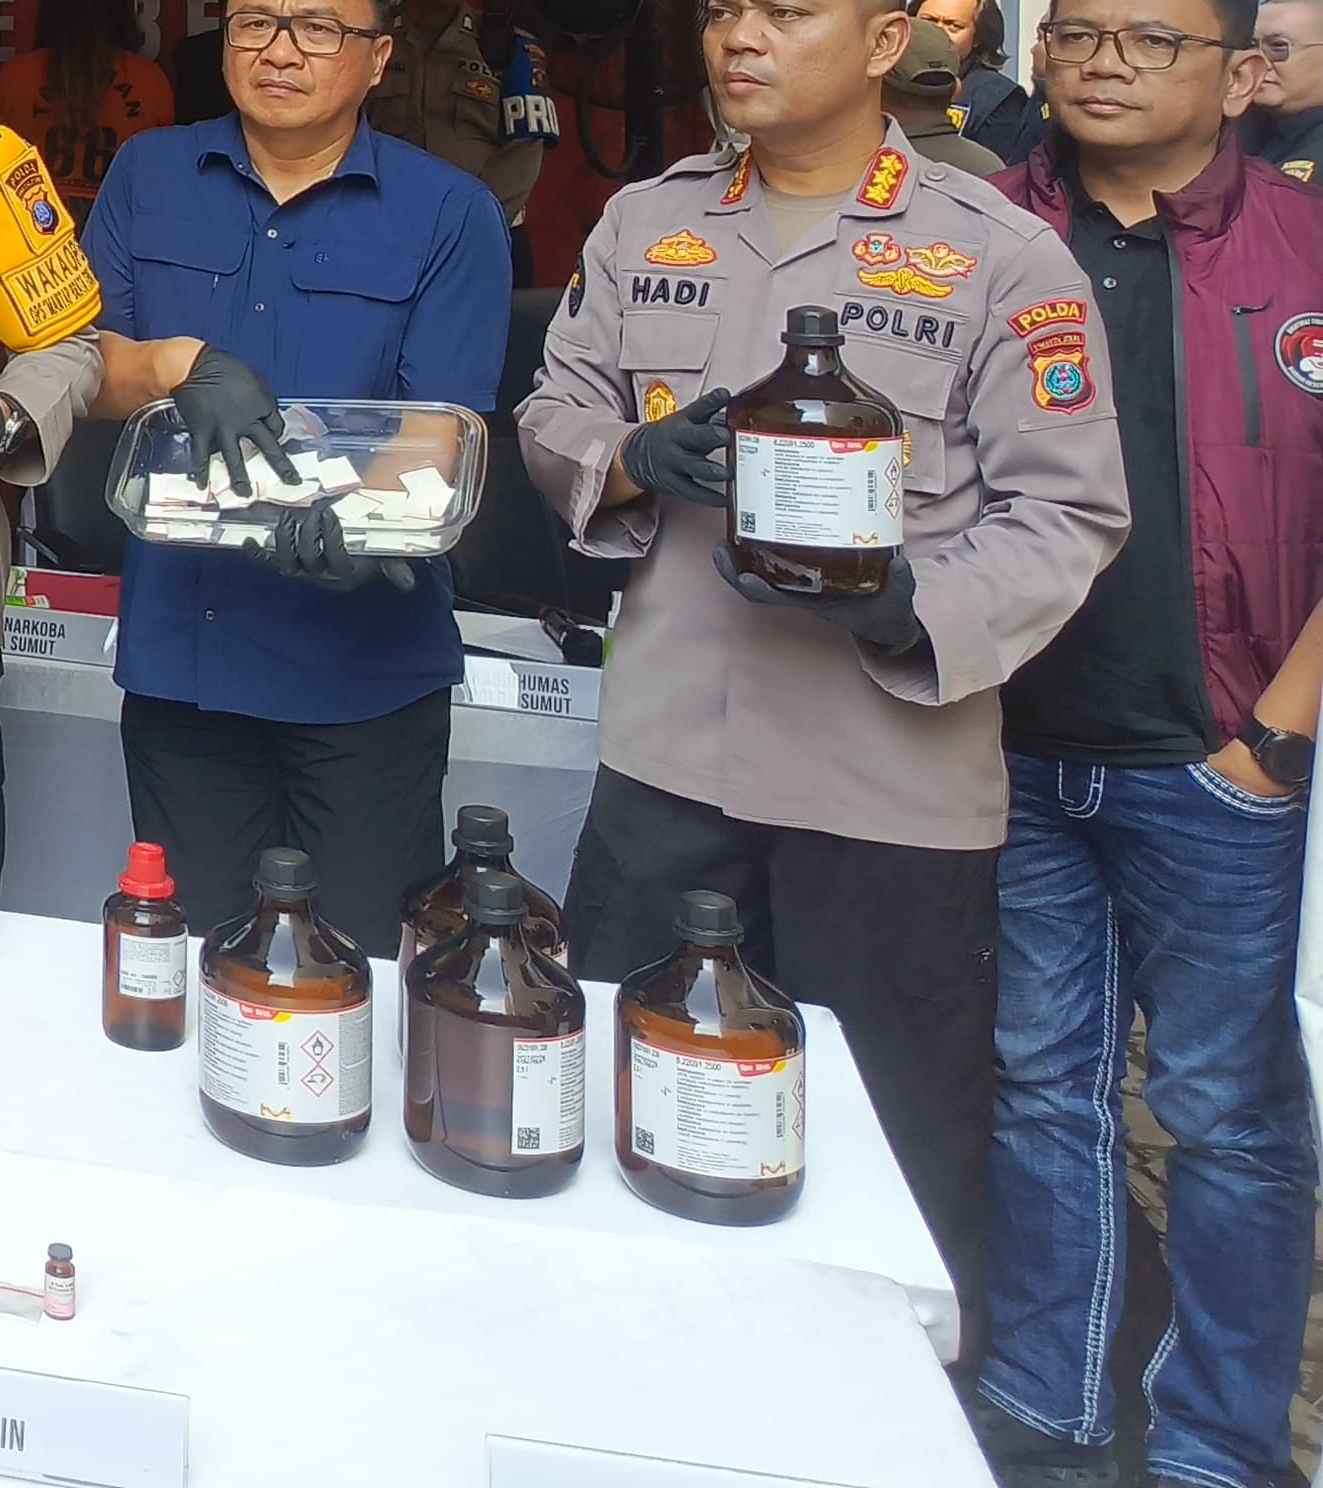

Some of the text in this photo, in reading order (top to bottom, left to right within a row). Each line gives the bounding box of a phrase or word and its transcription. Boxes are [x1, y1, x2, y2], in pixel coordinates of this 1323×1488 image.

[631, 274, 710, 308] HADI
[841, 301, 955, 349] POLRI
[1018, 302, 1080, 331] POLDA
[4, 616, 66, 639] NARKOBA
[10, 635, 57, 656] SUMUT
[518, 673, 569, 695] HUMAS
[520, 693, 573, 714] SUMUT
